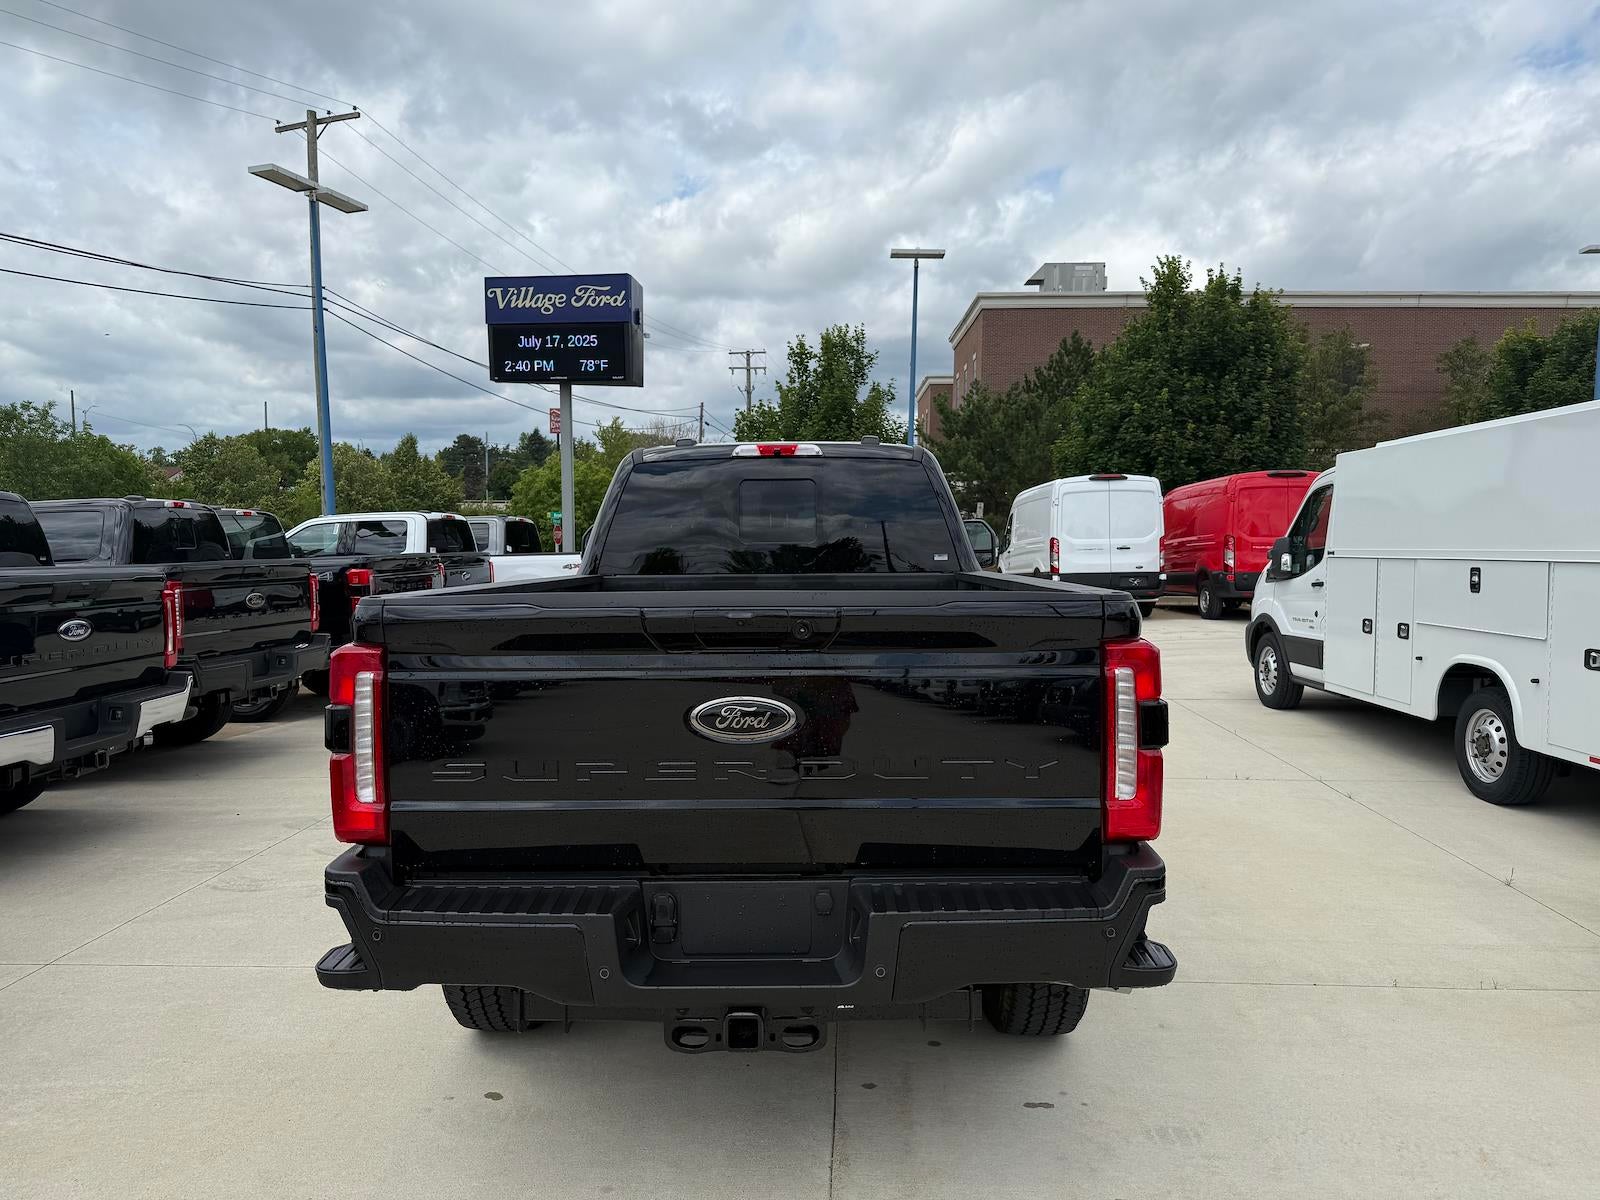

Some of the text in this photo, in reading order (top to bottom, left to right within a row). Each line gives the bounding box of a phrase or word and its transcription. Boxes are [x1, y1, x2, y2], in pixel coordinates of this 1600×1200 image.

[487, 285, 626, 314] Village Ford
[518, 335, 598, 350] July 17, 2025
[504, 360, 555, 372] 2:40 PM
[579, 359, 609, 371] 78°F
[431, 759, 1058, 782] SUPER DUTY
